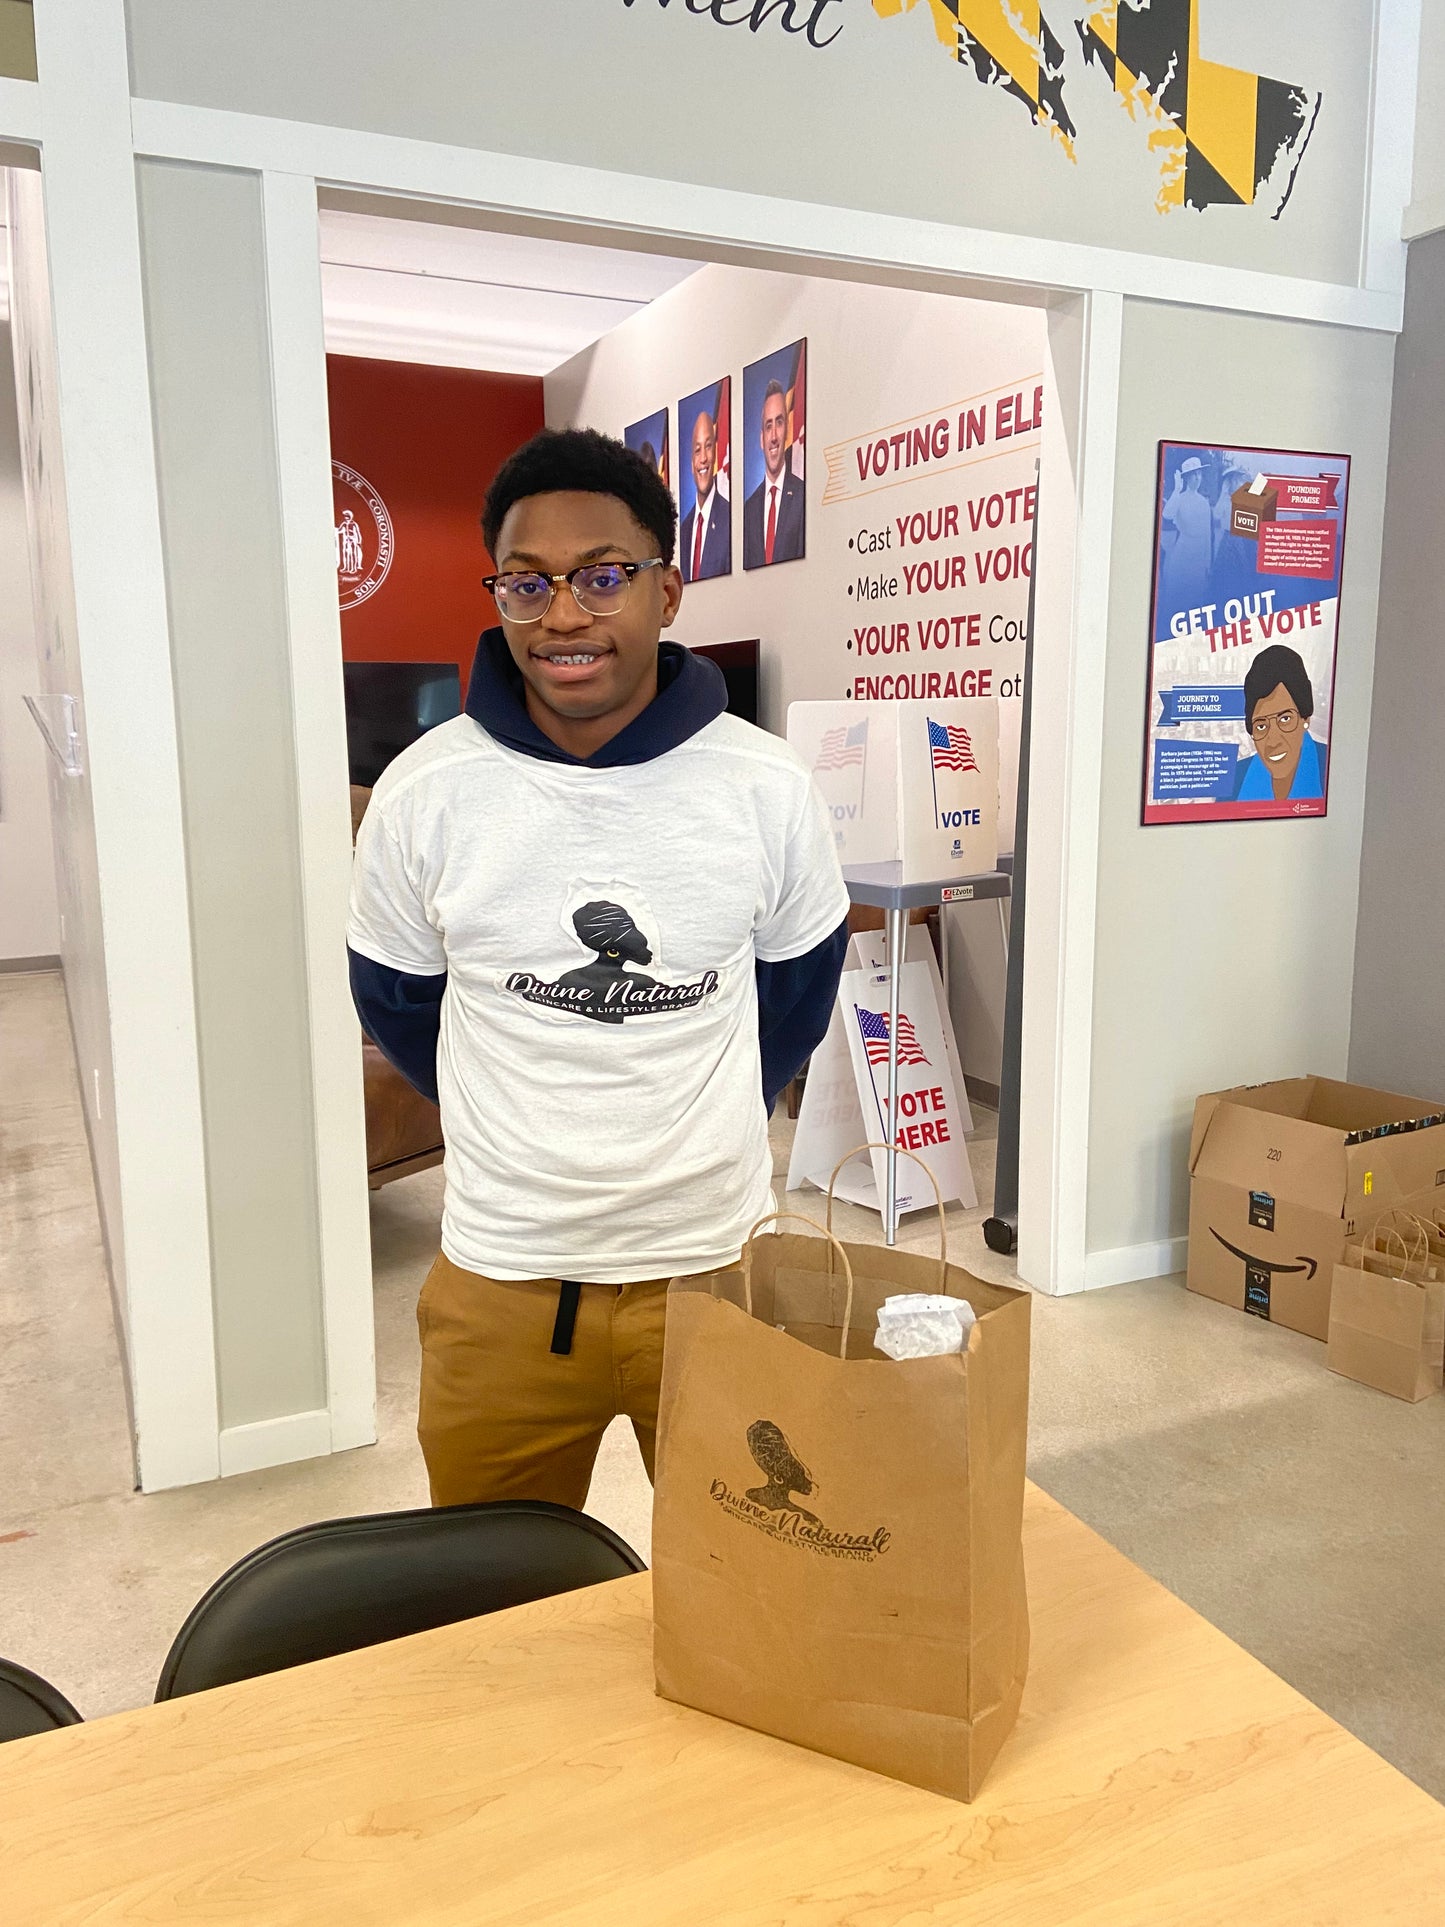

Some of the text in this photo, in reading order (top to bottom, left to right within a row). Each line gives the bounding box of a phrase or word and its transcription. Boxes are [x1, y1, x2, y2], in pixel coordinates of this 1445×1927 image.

[622, 0, 844, 48] ent
[856, 417, 949, 481] VOTING
[957, 404, 986, 452] IN
[1287, 485, 1321, 495] FOUNDING
[1291, 495, 1320, 505] PROMISE
[368, 498, 390, 568] CORONASTI
[857, 485, 1037, 554] Cast YOUR VOTE
[1237, 517, 1255, 527] VOTE
[856, 574, 898, 602] Make
[903, 555, 966, 595] YOUR
[1170, 589, 1276, 638] GET OUT
[1205, 601, 1322, 653] THE VOTE
[853, 623, 910, 656] YOUR
[917, 613, 981, 650] VOTE
[854, 669, 992, 700] ENCOURAGE
[1177, 695, 1209, 703] JOURNEY
[1192, 704, 1222, 712] PROMISE
[942, 809, 981, 828] VOTE
[952, 888, 973, 896] EZvote
[509, 974, 594, 1001] Divine
[528, 994, 581, 1012] SKINCARE
[597, 1005, 657, 1013] LIFESTYLE
[1267, 1148, 1282, 1162] 220
